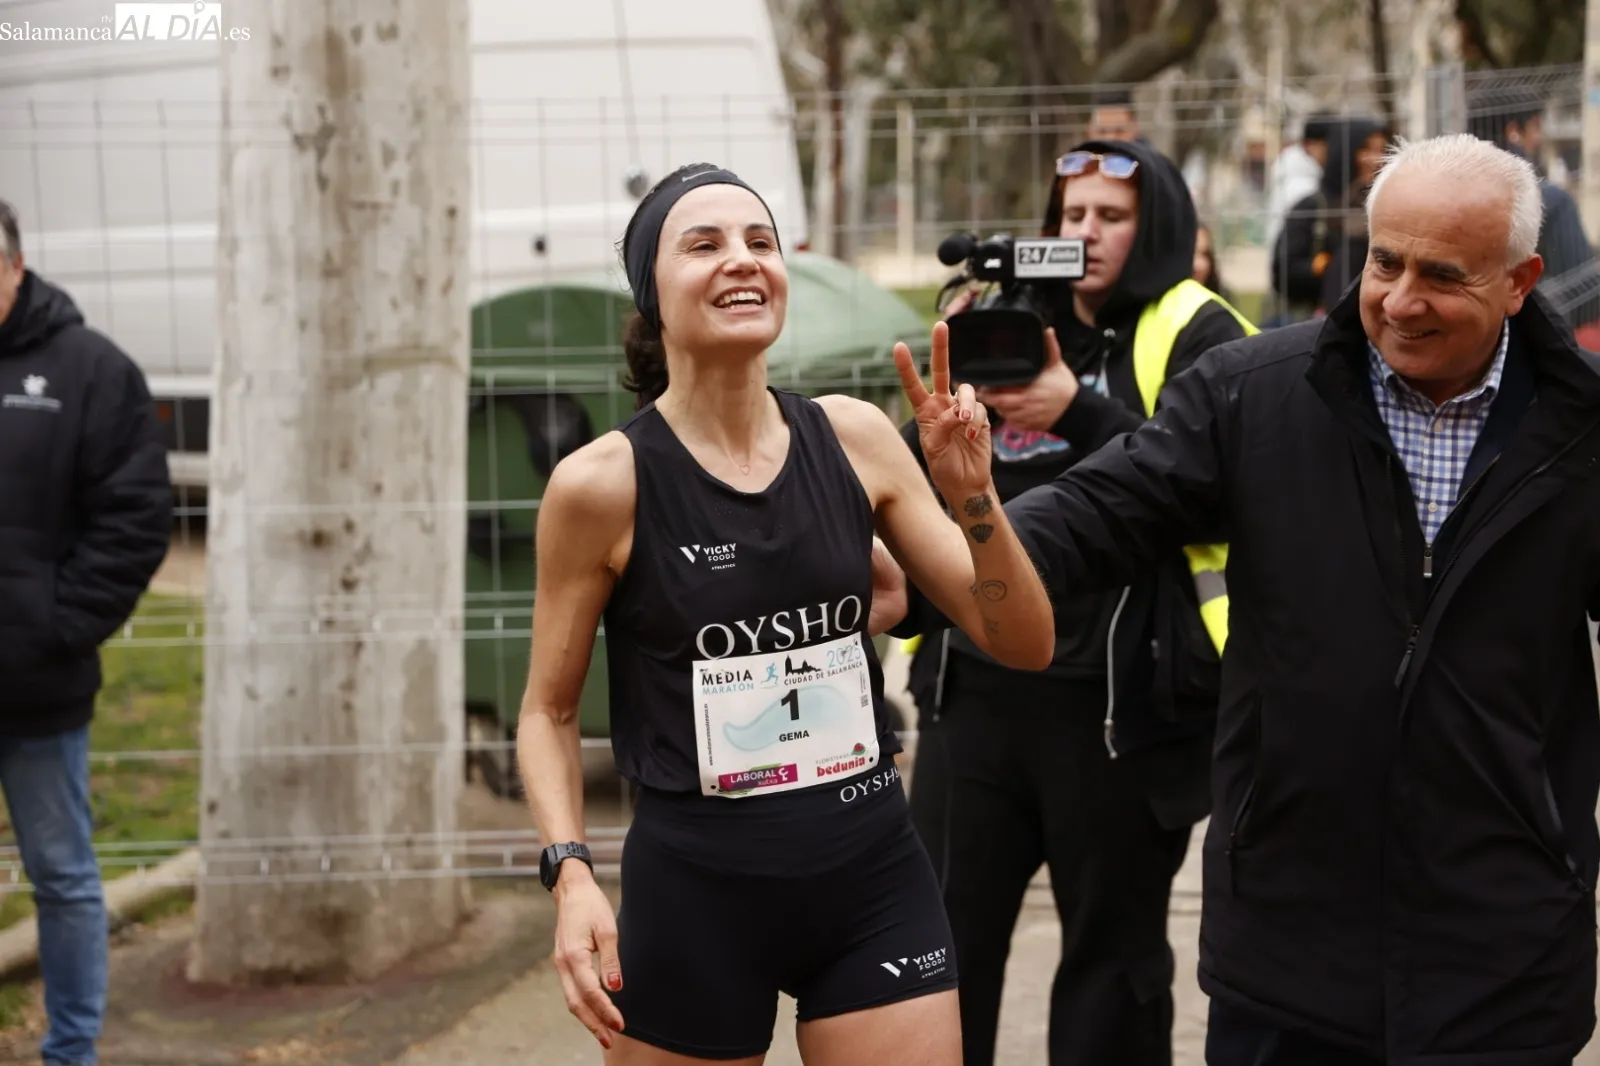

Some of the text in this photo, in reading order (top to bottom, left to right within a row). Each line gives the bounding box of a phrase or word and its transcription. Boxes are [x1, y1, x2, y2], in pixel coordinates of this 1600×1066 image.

[1020, 247, 1041, 262] 24
[703, 543, 736, 555] VICKY
[708, 552, 736, 562] FOODS
[696, 595, 862, 660] OYSHO
[702, 669, 753, 686] MEDIA
[784, 675, 813, 686] CIUDAD
[827, 661, 863, 677] SALAMANCA
[781, 688, 799, 721] 1
[779, 730, 809, 742] GEMA
[816, 756, 866, 777] bedunia
[730, 769, 777, 783] LABORAL
[912, 947, 946, 965] VICKY
[919, 956, 946, 971] FOODS
